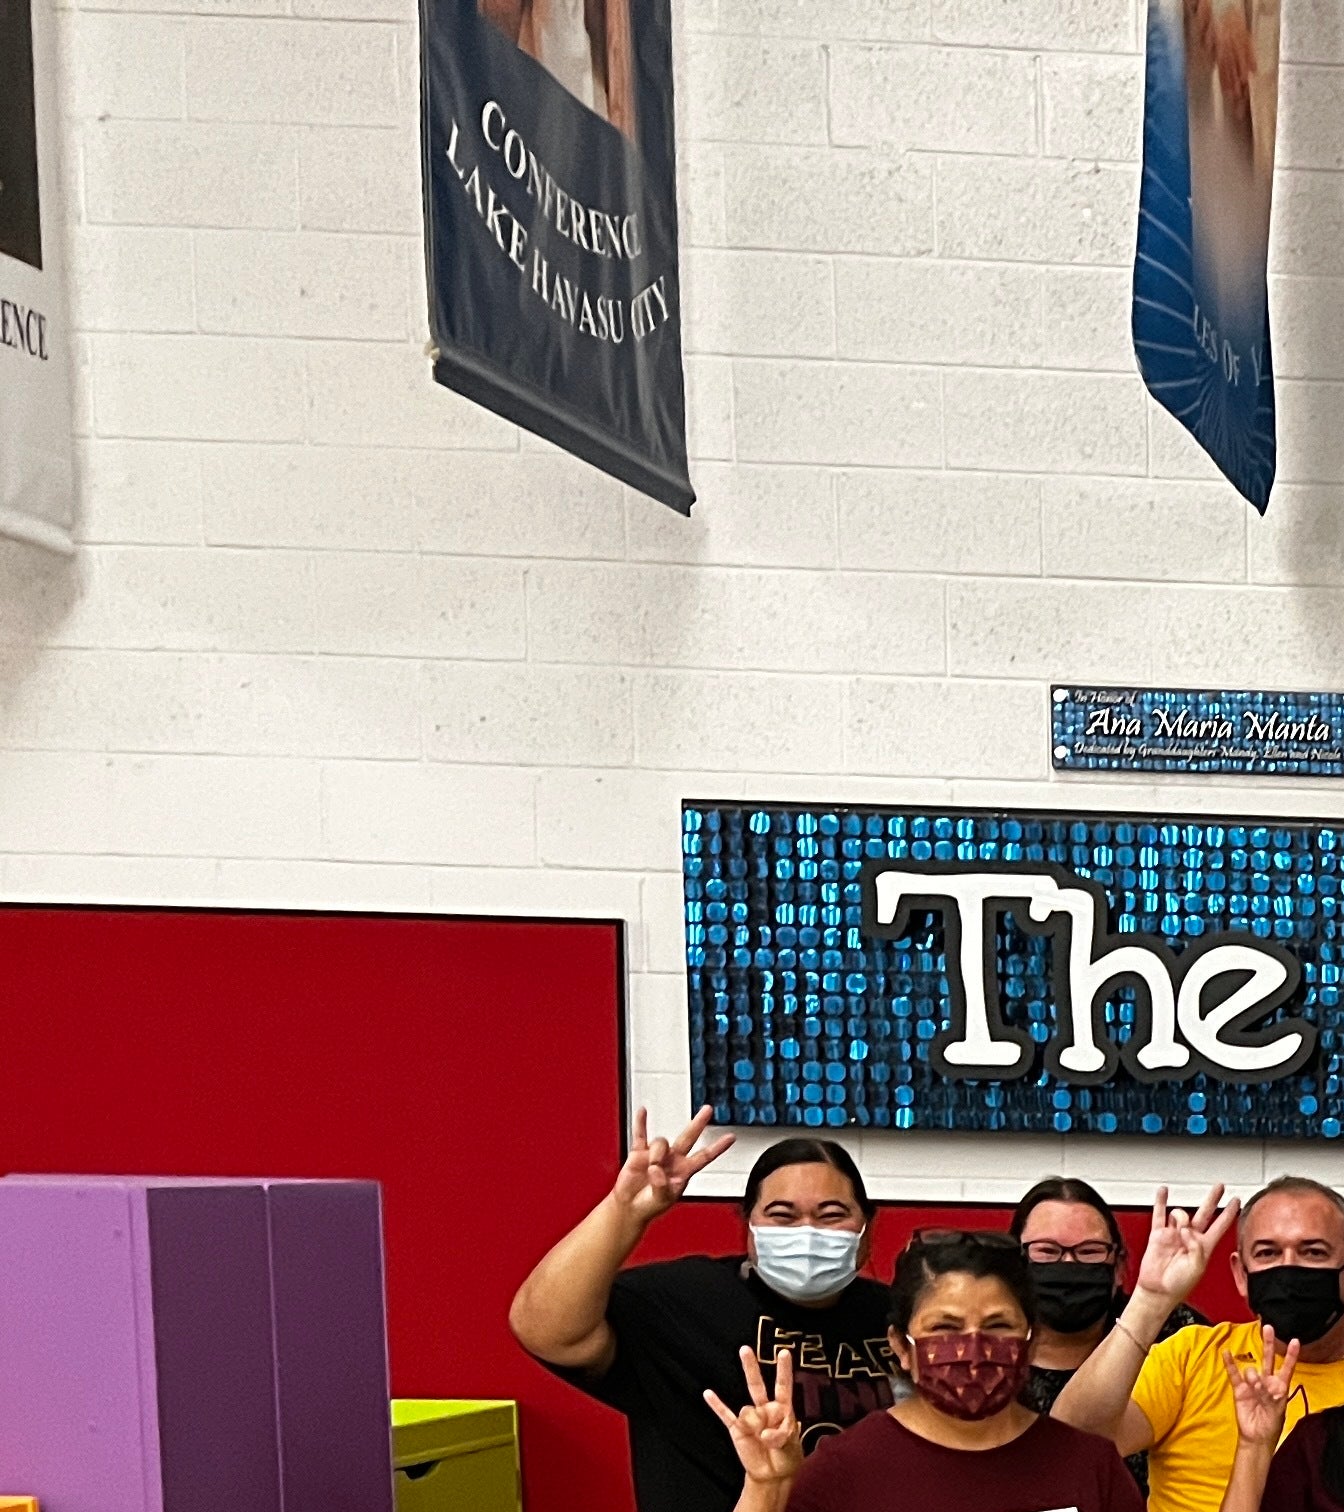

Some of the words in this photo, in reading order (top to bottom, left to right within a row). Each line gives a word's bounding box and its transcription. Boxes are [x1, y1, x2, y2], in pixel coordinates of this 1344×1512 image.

[446, 118, 528, 272] LAKE
[532, 247, 625, 344] HAVASU
[630, 276, 670, 342] CITY
[1086, 708, 1141, 736] Ana
[1152, 709, 1233, 738] Maria
[1243, 712, 1330, 741] Manta
[877, 871, 1303, 1073] The
